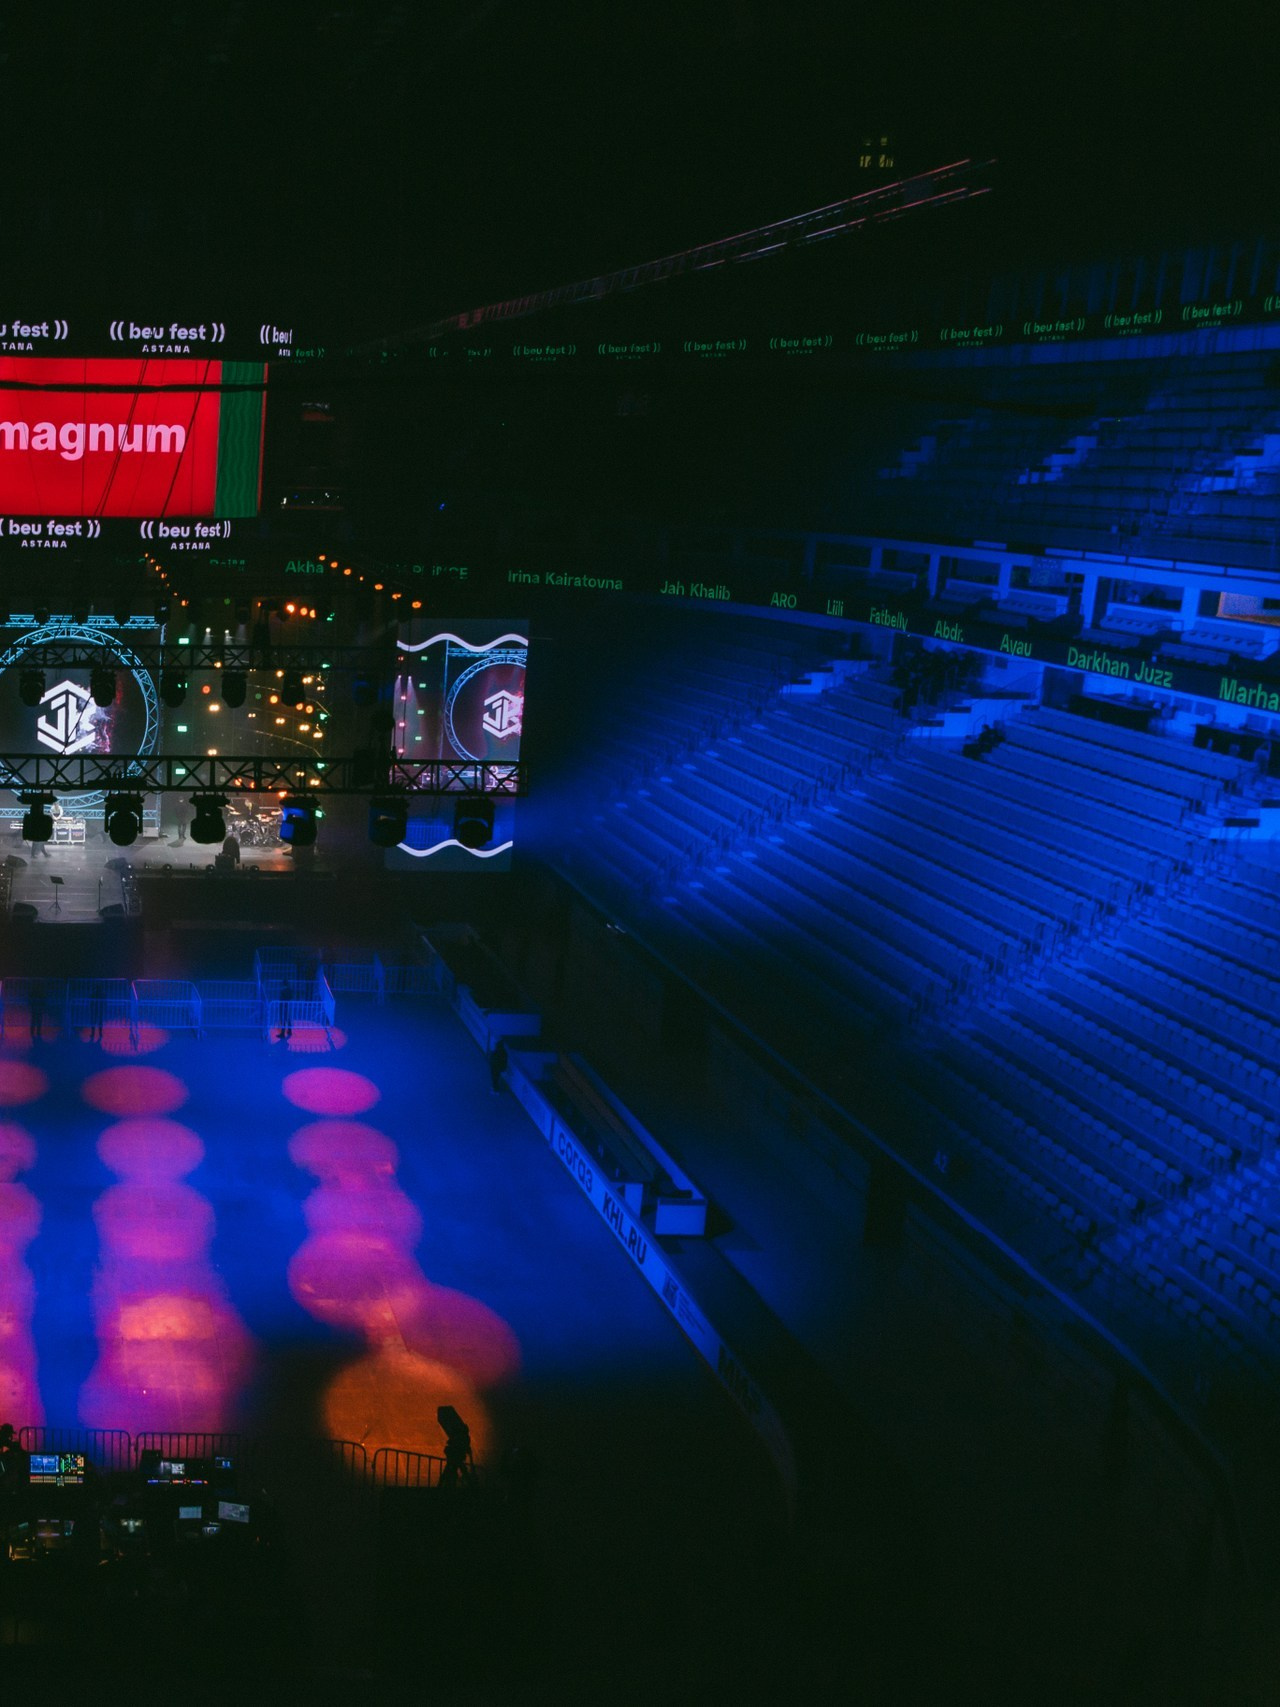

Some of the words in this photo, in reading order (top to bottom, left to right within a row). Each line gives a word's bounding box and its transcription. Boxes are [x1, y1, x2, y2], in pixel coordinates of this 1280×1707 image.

[12, 320, 49, 338] fest
[129, 322, 164, 340] beu
[169, 323, 206, 340] fest
[142, 344, 190, 353] ASTANA
[8, 520, 41, 535] beu
[47, 520, 82, 536] fest
[159, 522, 190, 537] beu
[194, 522, 221, 538] fest
[21, 540, 67, 548] ASTANA
[170, 542, 210, 550] ASTANA
[285, 560, 324, 574] Akha
[507, 569, 540, 584] Irina
[545, 571, 623, 590] Kairatovna
[660, 580, 685, 596] Jah
[689, 583, 731, 600] Khalib
[770, 592, 797, 608] ARO
[870, 607, 909, 632] Fatbelly
[1000, 634, 1032, 657] Ayau
[1067, 646, 1130, 679] Darkhan
[1134, 660, 1173, 689] Juzz
[1220, 677, 1280, 712] Marha
[602, 1192, 647, 1265] KHL.RU
